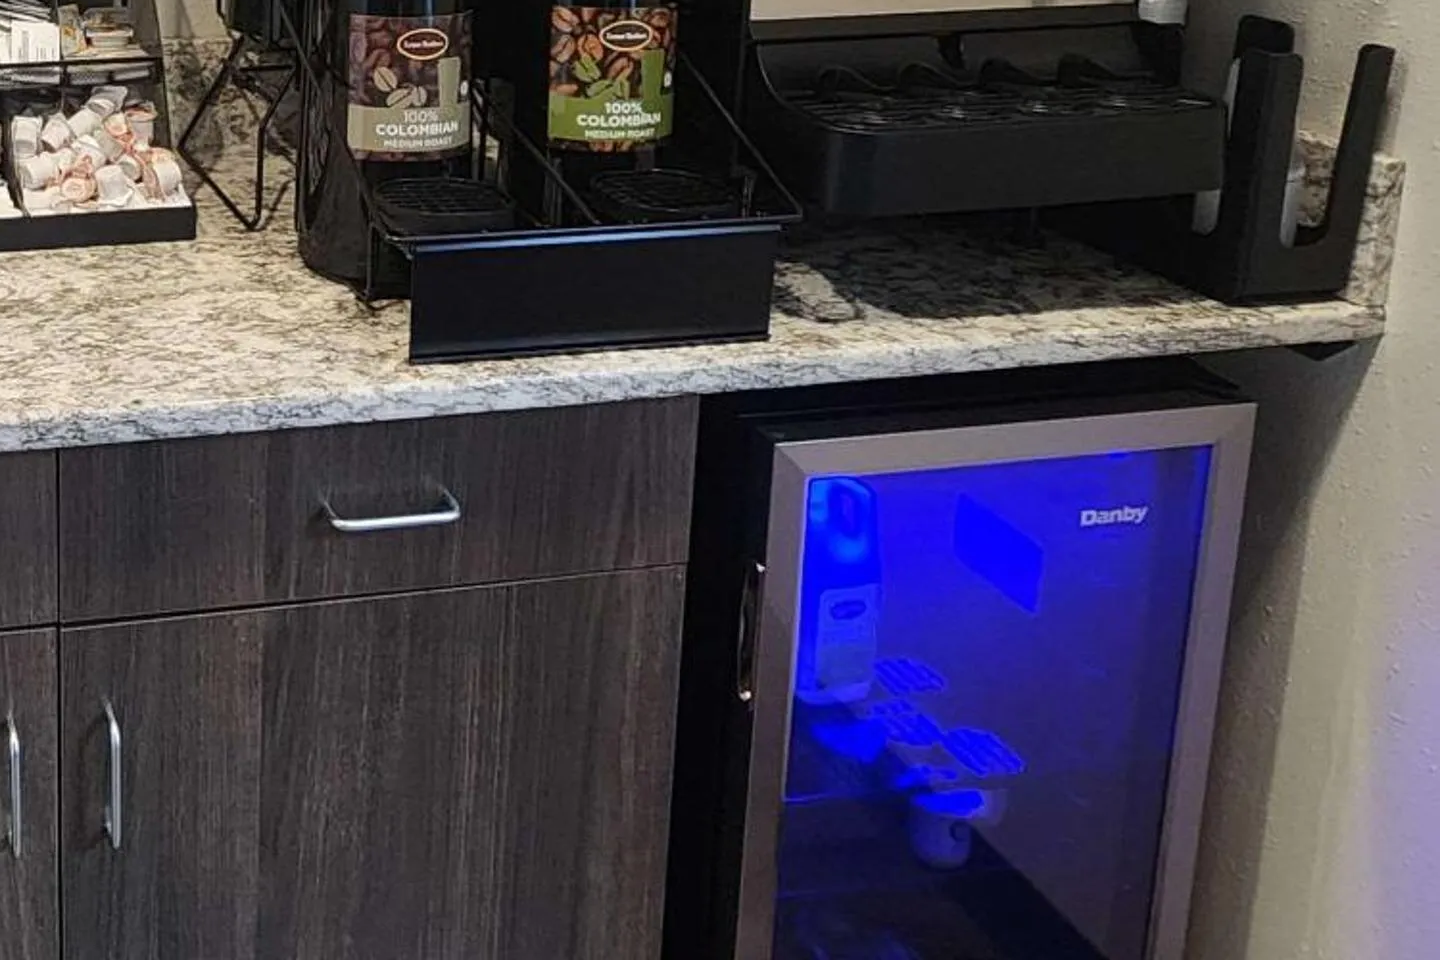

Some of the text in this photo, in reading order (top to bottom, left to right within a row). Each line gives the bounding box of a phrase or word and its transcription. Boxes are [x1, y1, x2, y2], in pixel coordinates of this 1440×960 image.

[404, 109, 439, 123] 100%
[604, 101, 642, 115] 100%
[576, 111, 661, 128] COLOMBIAN
[375, 121, 459, 137] COLOMBIAN
[1080, 505, 1148, 528] Danby
